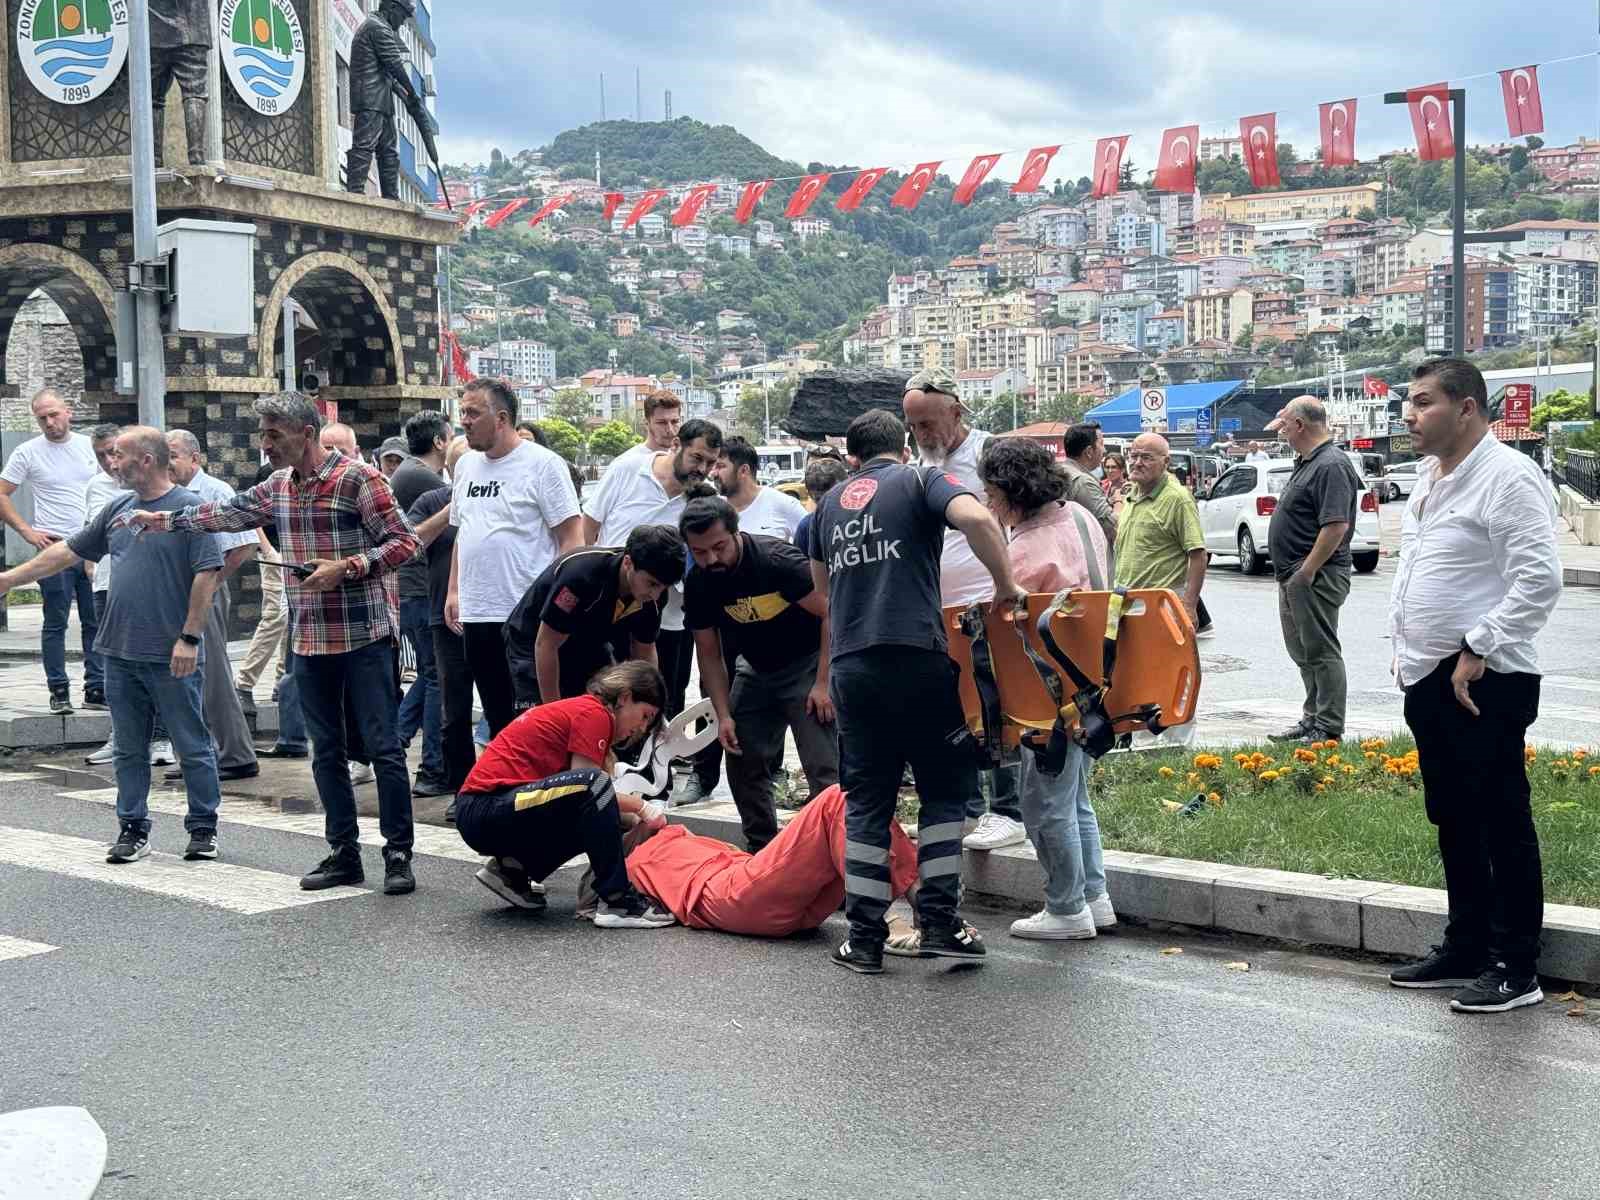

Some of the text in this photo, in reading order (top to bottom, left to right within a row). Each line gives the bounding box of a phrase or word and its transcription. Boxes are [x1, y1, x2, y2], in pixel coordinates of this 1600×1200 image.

[62, 85, 91, 101] 1899
[255, 96, 278, 113] 1899
[1513, 401, 1522, 411] P
[466, 480, 501, 498] levi's
[832, 514, 882, 545] ACİL
